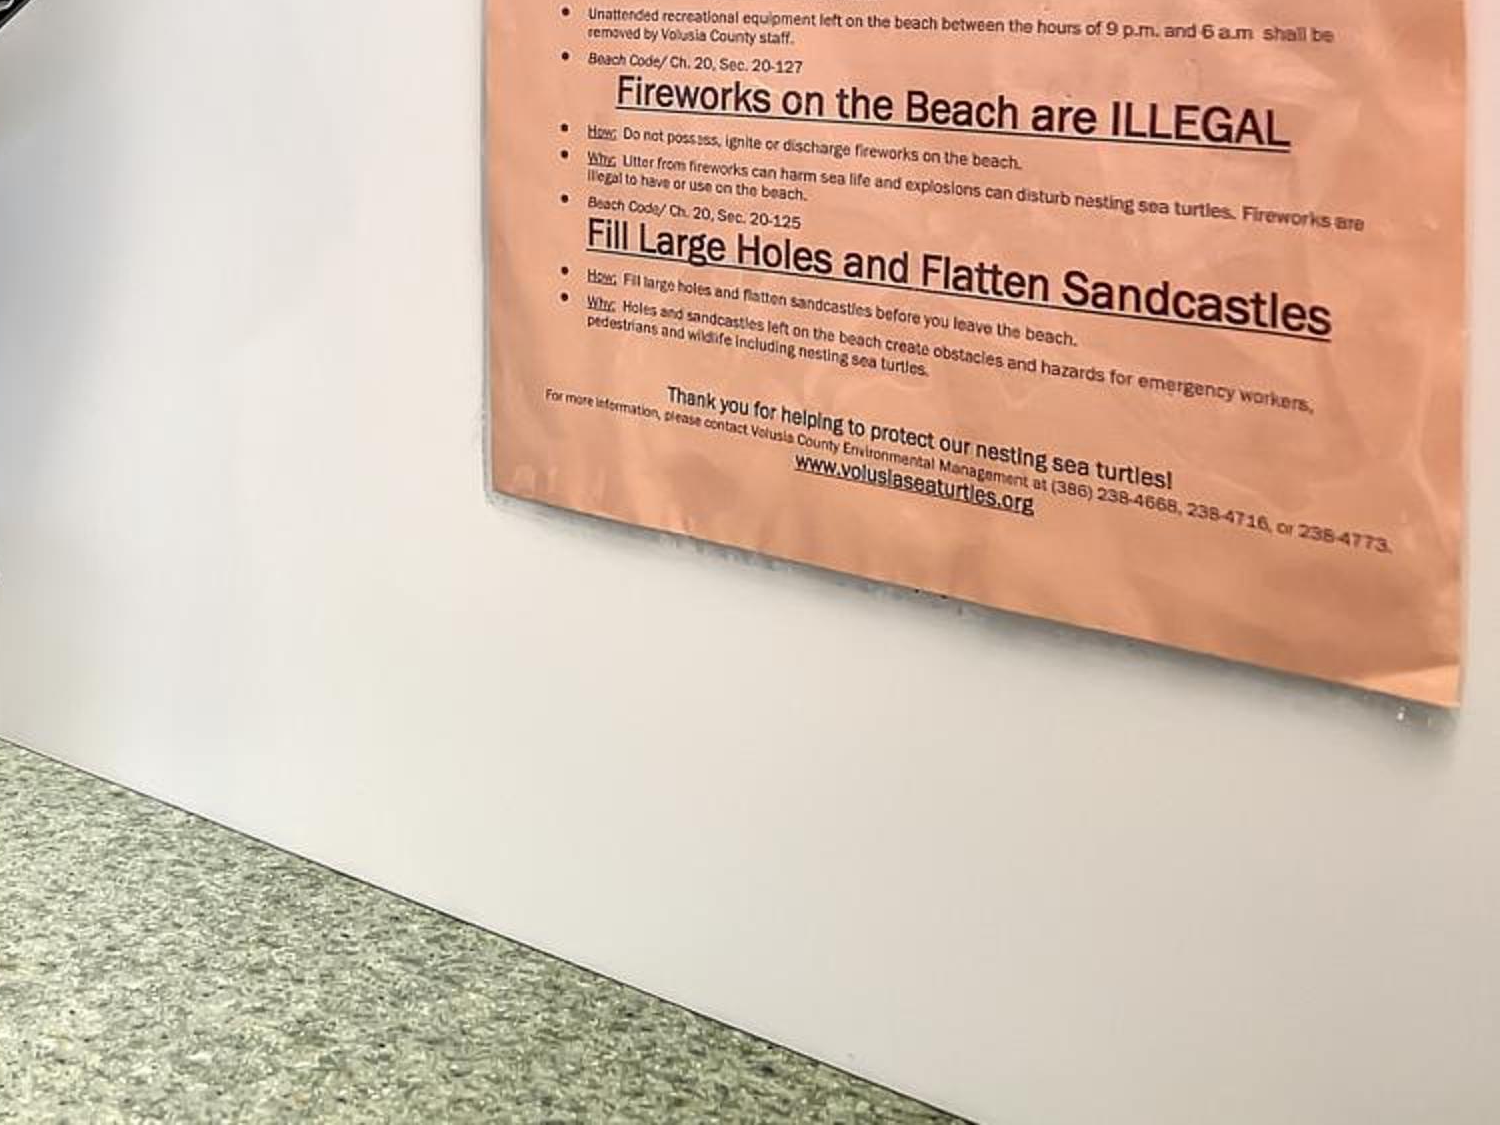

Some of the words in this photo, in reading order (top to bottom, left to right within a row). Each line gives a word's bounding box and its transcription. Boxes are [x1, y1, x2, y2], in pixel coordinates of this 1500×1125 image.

[587, 26, 641, 41] removed
[643, 26, 659, 46] by
[660, 27, 707, 43] Volusia
[709, 28, 757, 48] County
[759, 30, 794, 46] staff.
[587, 51, 627, 67] Beach
[669, 54, 691, 69] Ch.
[693, 54, 717, 74] 20,
[719, 55, 749, 71] Sec.
[751, 56, 803, 73] 20-127
[615, 76, 771, 114] Fireworks
[781, 91, 824, 117] on
[835, 85, 893, 120] the
[906, 89, 1018, 128] Beach
[1031, 106, 1097, 134] are
[1112, 103, 1291, 143] ILLEGAL
[623, 126, 641, 142] Do
[643, 128, 664, 143] not
[725, 132, 762, 152] ignite
[765, 139, 780, 150] or
[782, 136, 851, 159] discharge
[855, 141, 919, 162] fireworks
[922, 151, 941, 164] on
[944, 149, 969, 166] the
[972, 151, 1023, 168] beach.
[587, 196, 625, 213] Beach
[669, 202, 690, 219] Ch.
[692, 204, 715, 225] 20,
[717, 206, 747, 224] Sec.
[749, 210, 802, 229] 20-125
[586, 219, 633, 254] Fill
[639, 223, 726, 271] Large
[737, 233, 833, 275] Holes
[843, 249, 909, 284] and
[922, 255, 1049, 301] Flatten
[1061, 272, 1332, 335] Sandcastles
[623, 272, 641, 289] Fill
[643, 275, 675, 296] large
[677, 278, 712, 297] holes
[714, 284, 740, 300] and
[743, 286, 787, 306] flatten
[790, 295, 873, 317] sandcastles
[875, 303, 921, 324] before
[923, 313, 950, 329] you
[953, 314, 993, 335] leave
[996, 321, 1021, 339] the
[1025, 324, 1077, 345] beach.
[587, 314, 659, 335] pedestrians
[661, 322, 685, 338] and
[687, 325, 733, 345] wildlife
[735, 331, 797, 360] including
[798, 345, 849, 369] nesting
[851, 354, 877, 369] sea
[880, 355, 929, 375] turtles.
[668, 386, 717, 410] Thank
[719, 397, 749, 418] you
[753, 398, 777, 421] for
[781, 403, 844, 439] helping
[847, 416, 866, 437] to
[870, 424, 935, 448] protect
[939, 436, 971, 456] our
[976, 444, 1049, 474] nesting
[1052, 456, 1090, 476] sea
[1095, 458, 1172, 488] turtles!
[795, 455, 1035, 516] www.volusiaseaturtles.org
